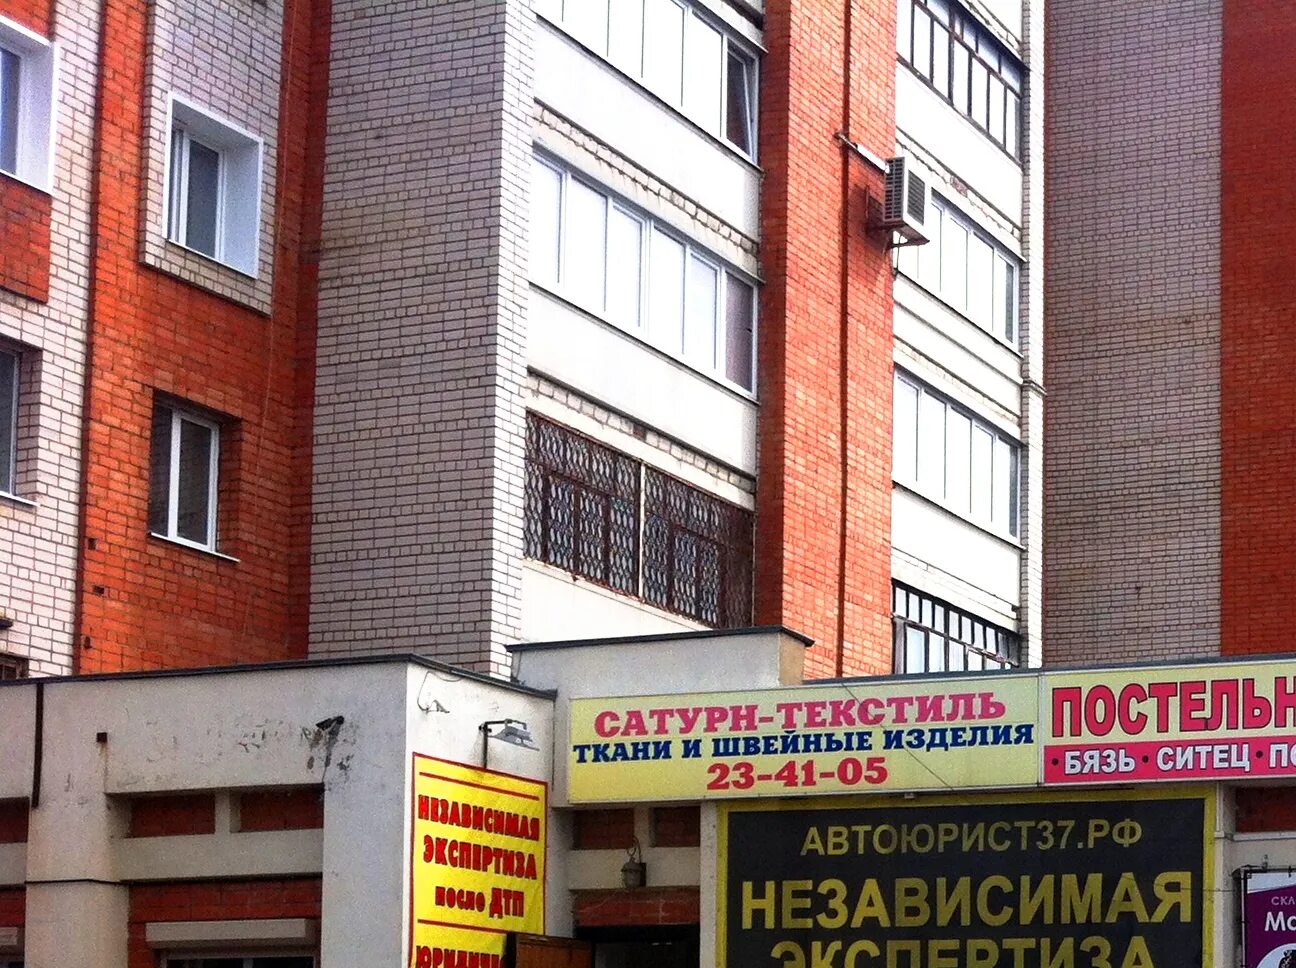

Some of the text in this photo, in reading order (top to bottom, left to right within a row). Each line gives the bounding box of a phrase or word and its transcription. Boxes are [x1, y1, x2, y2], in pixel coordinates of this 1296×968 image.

[594, 692, 1006, 738] САТУРН-ТЕКСТИЛЬ
[573, 724, 1034, 764] ТКАНИ И ШВЕЙНЫЕ ИЗДЕЛИЯ
[1064, 748, 1137, 775] БЯЗЬ
[1156, 743, 1250, 772] СИТЕЦ
[706, 757, 888, 790] 23-41-05
[418, 794, 540, 841] НЕЗАВИСИМАЯ
[801, 819, 1143, 856] АВТОЮРИСТ37.РФ
[423, 834, 537, 880] ЭКСПЕРТИЗА
[489, 887, 524, 918] ДТП
[742, 871, 1193, 930] НЕЗАВИСИМАЯ
